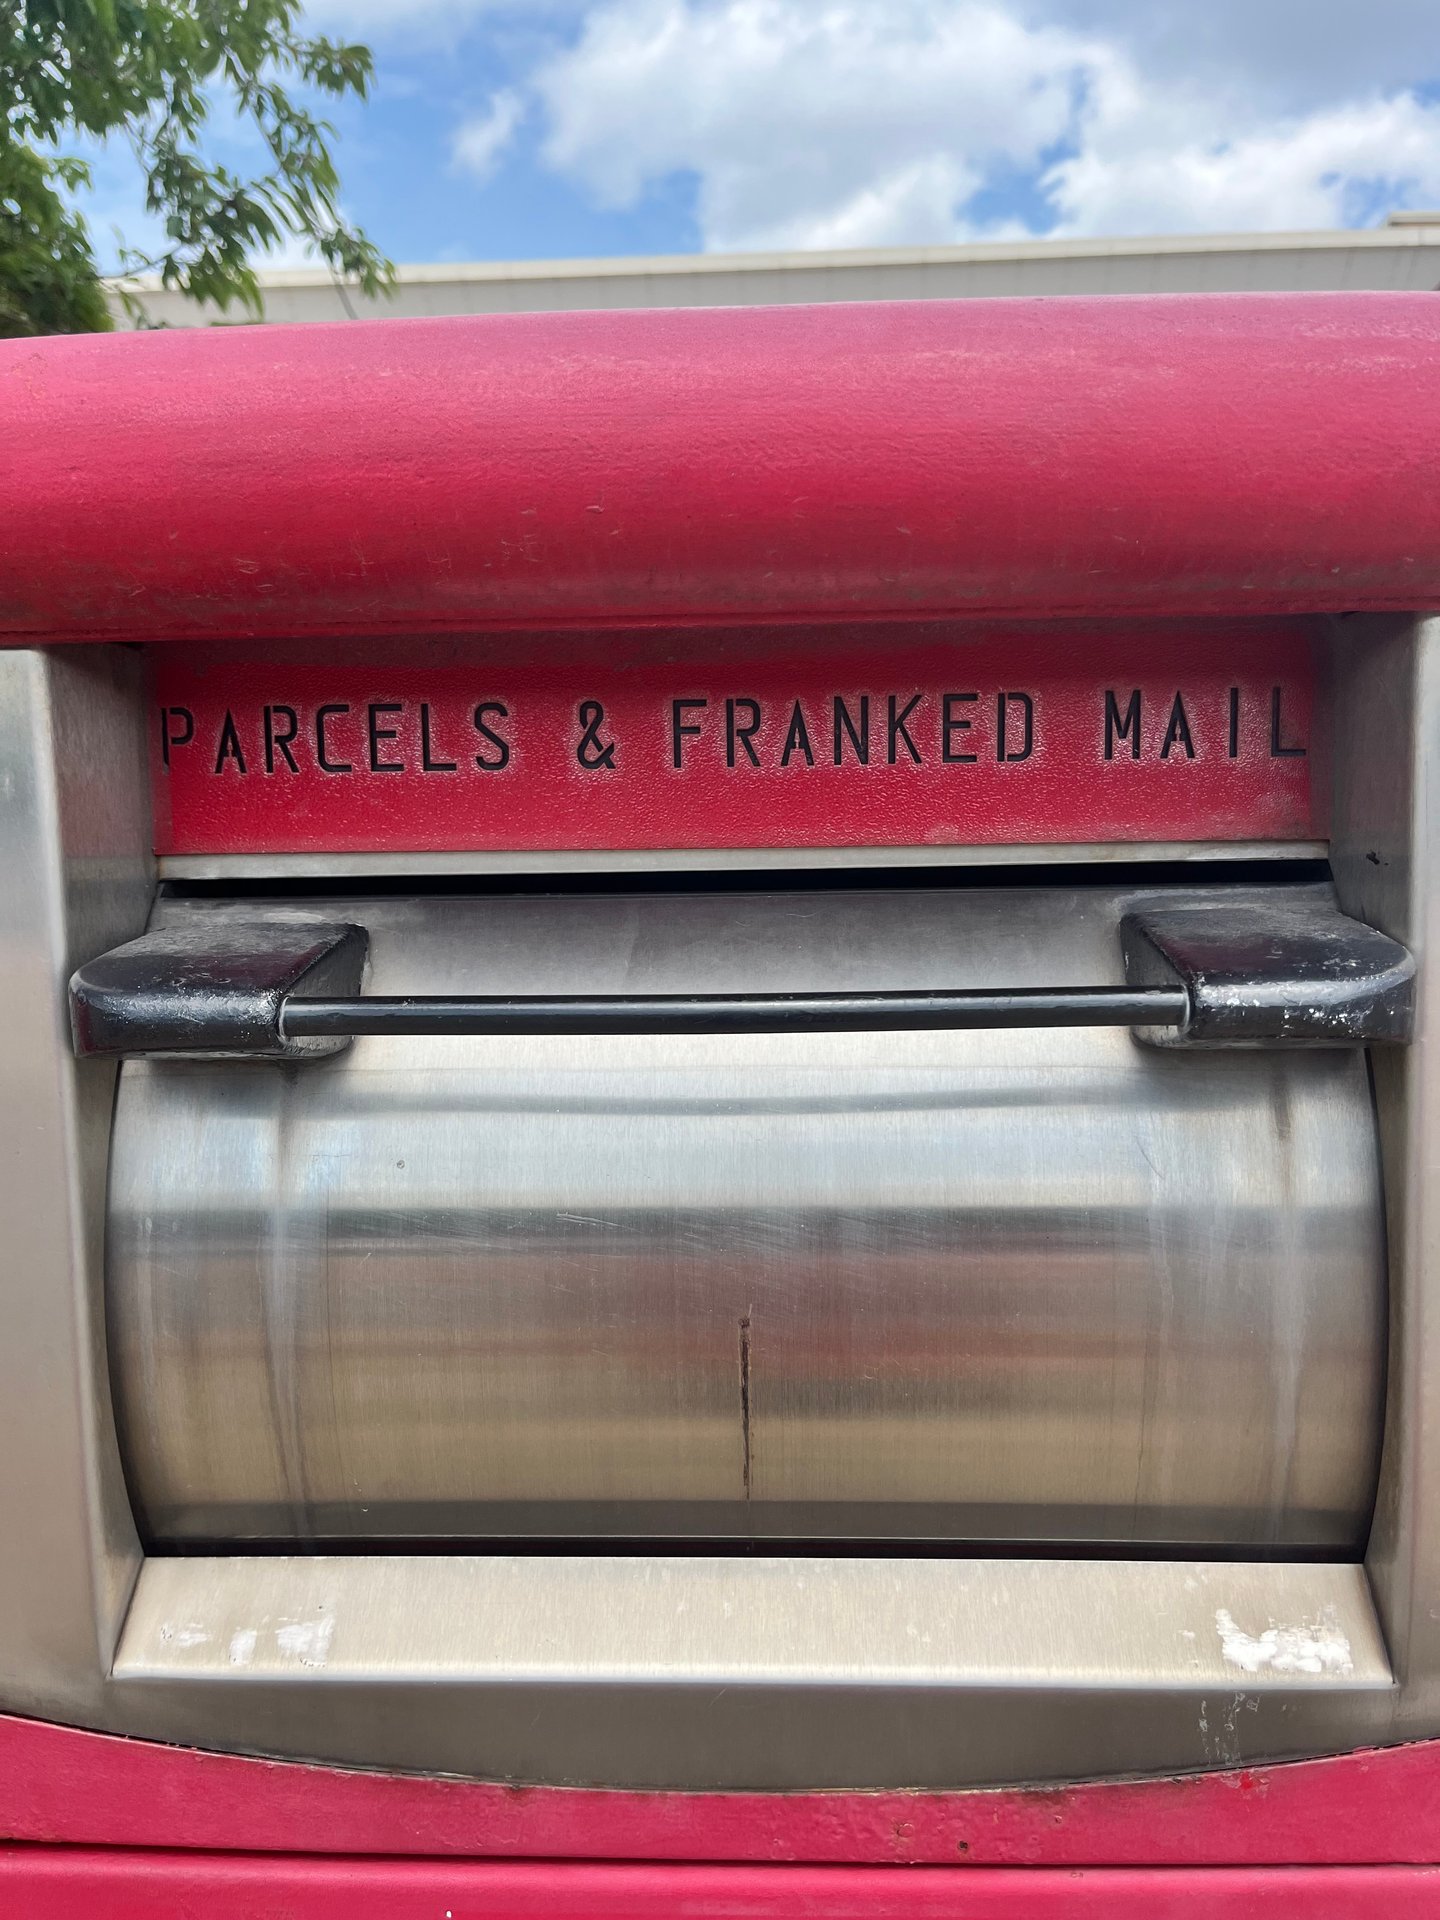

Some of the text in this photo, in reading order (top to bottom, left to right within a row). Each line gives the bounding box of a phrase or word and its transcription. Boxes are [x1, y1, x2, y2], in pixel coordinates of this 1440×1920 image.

[161, 687, 1307, 773] PARCELS & FRANKED MAIL
